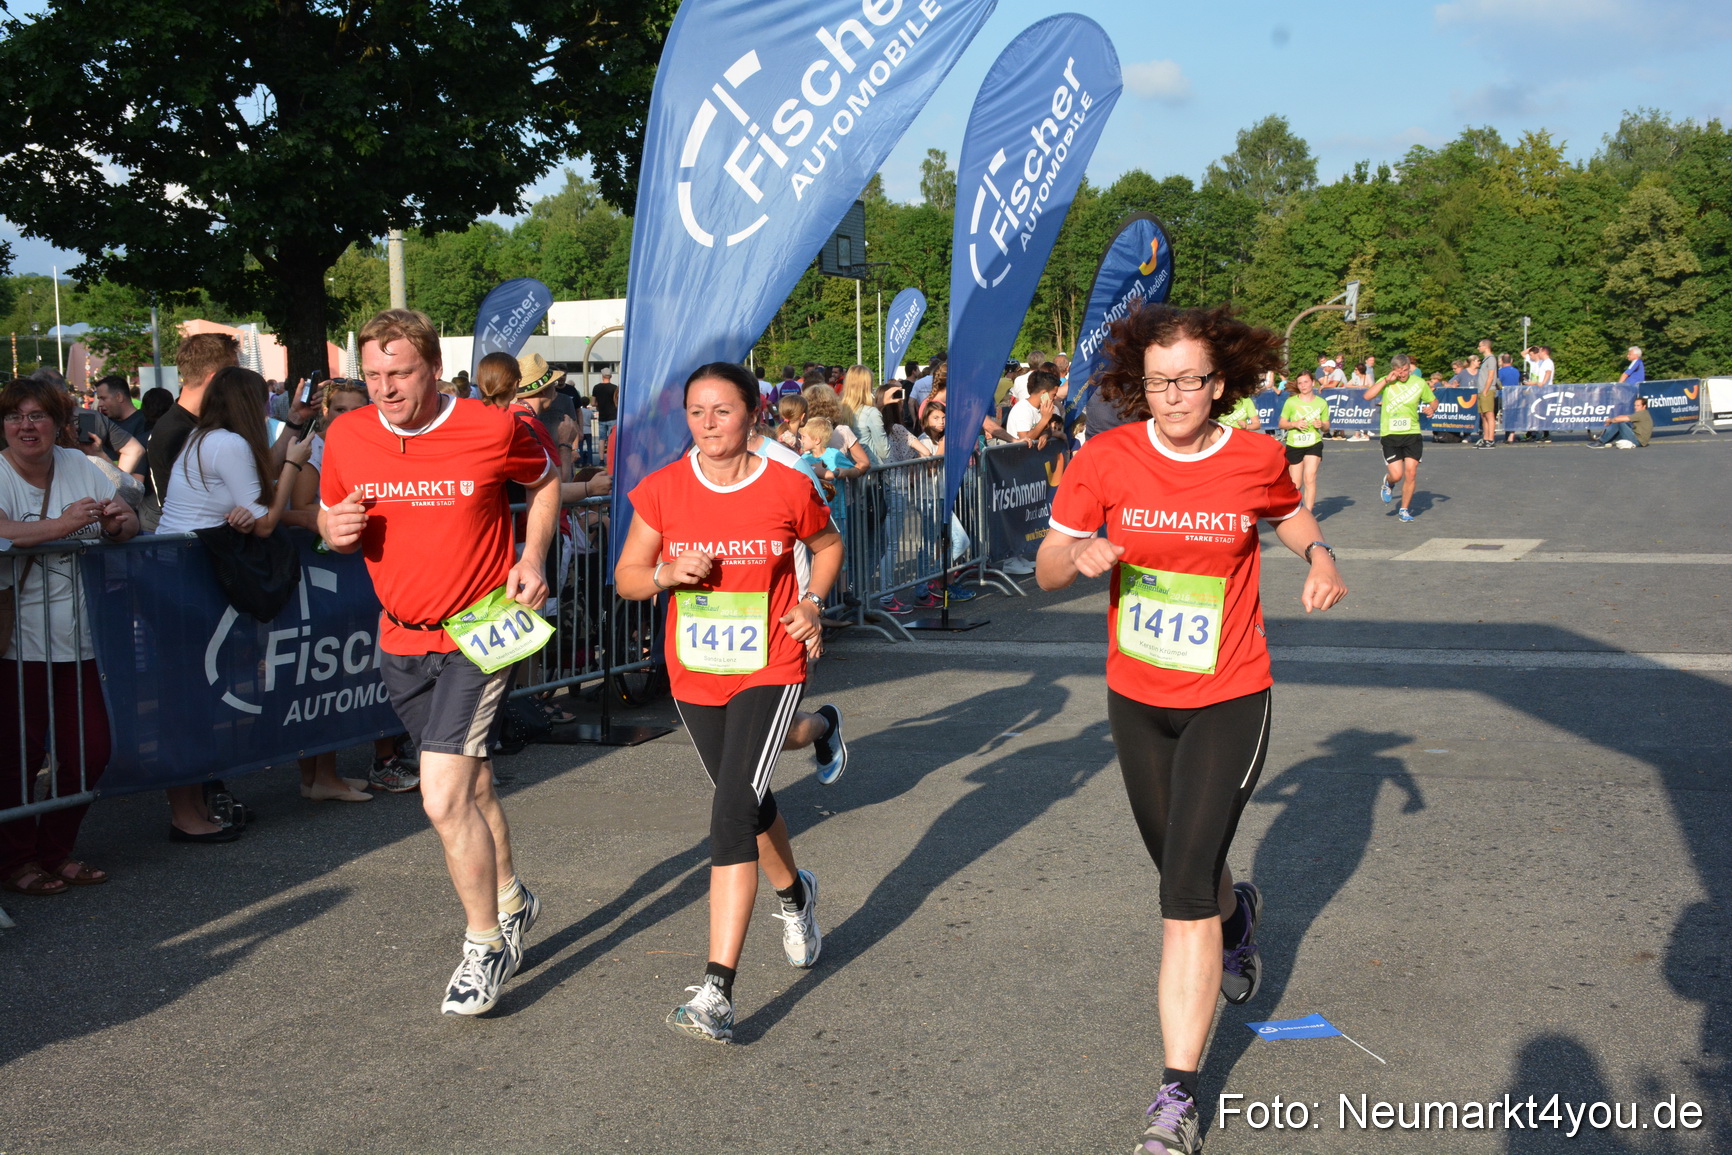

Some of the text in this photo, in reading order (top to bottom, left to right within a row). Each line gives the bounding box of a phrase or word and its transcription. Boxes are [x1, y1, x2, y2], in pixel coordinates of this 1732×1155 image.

[791, 0, 942, 201] AUTOMOBILE
[989, 56, 1080, 256] Fischer
[1020, 91, 1093, 252] AUTOMOBILE
[1148, 269, 1168, 298] Medien
[492, 291, 536, 348] Fischer
[507, 302, 541, 348] AUTOMOBILE
[894, 298, 918, 345] Fischer
[1328, 405, 1376, 418] Fischer
[1545, 403, 1615, 416] Fischer
[1643, 394, 1688, 408] rischmann
[1392, 419, 1408, 427] 208
[1038, 505, 1049, 519] und
[1121, 507, 1237, 531] NEUMARKT
[470, 610, 534, 656] 1410
[686, 622, 758, 651] 1412
[1129, 602, 1209, 645] 1413
[264, 611, 382, 692] Fisc
[1139, 640, 1188, 657] Kerstin Krümpel
